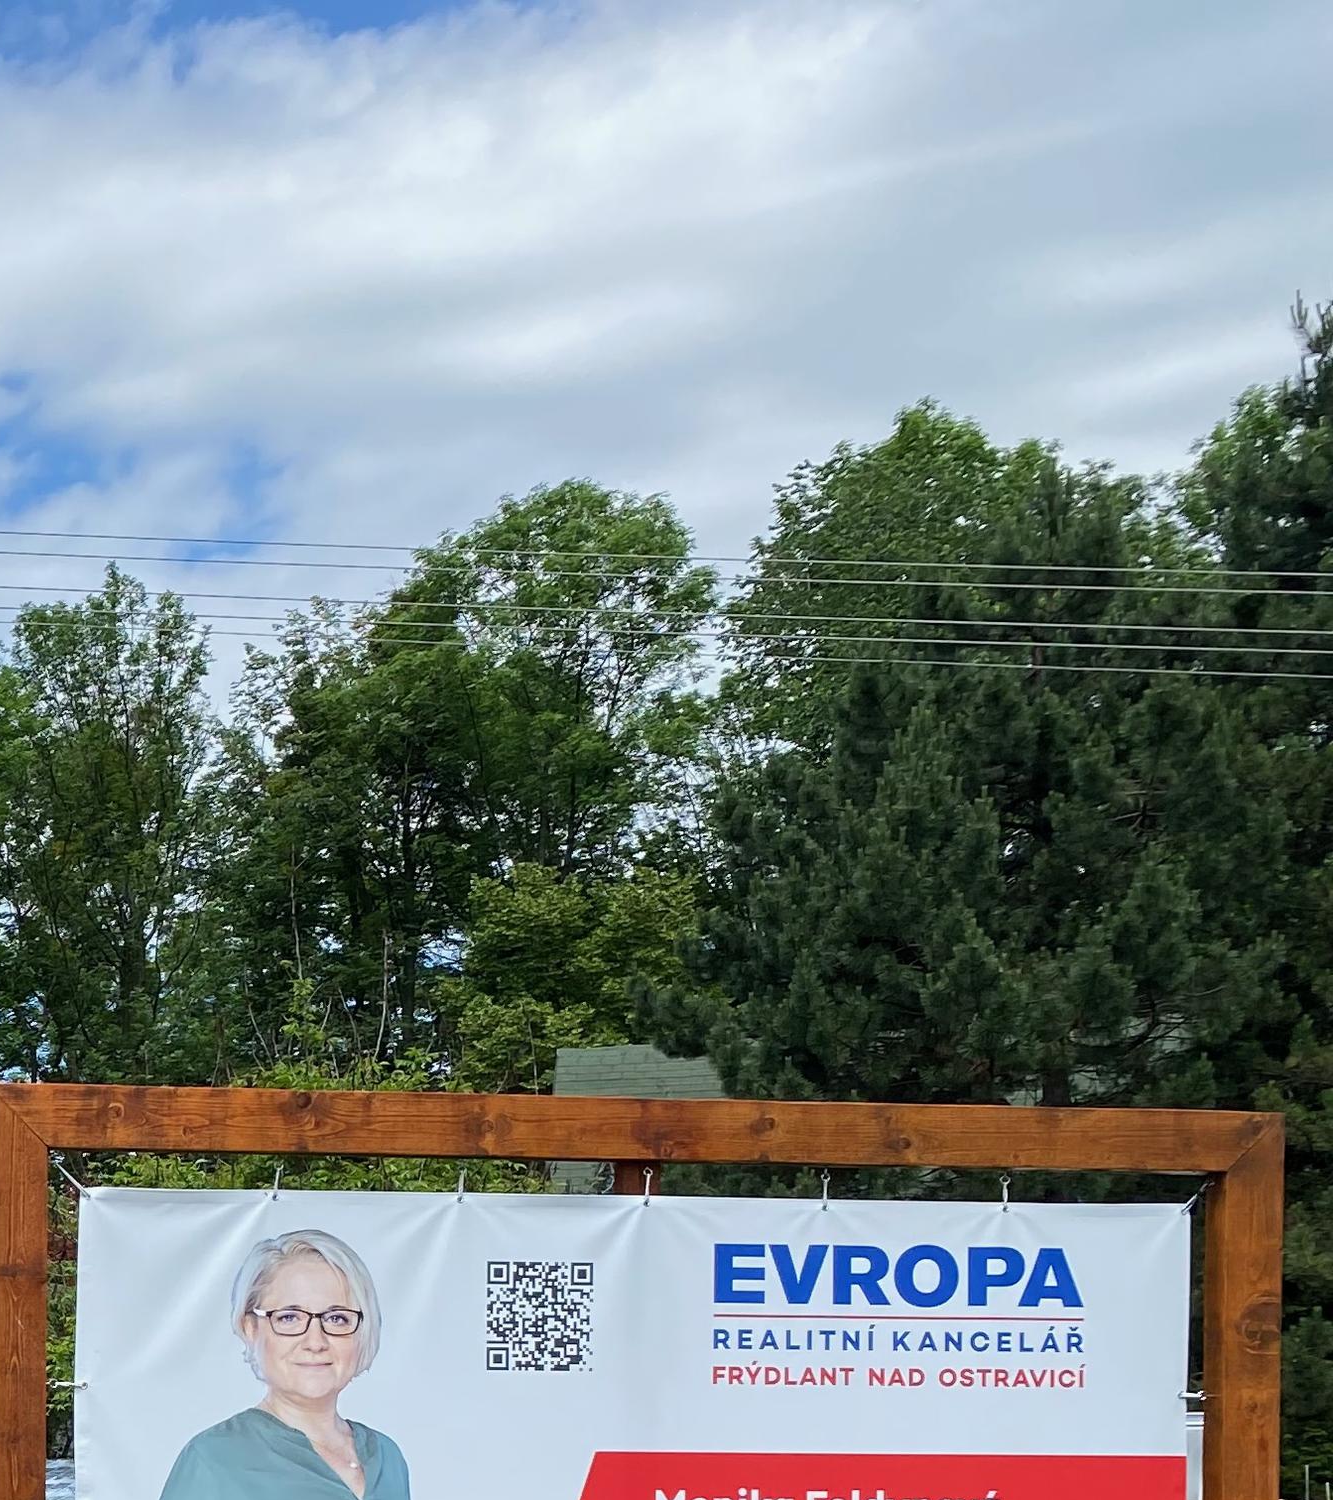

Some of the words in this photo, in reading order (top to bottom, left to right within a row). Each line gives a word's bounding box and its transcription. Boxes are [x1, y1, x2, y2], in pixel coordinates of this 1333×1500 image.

[712, 1241, 1085, 1308] EVROPA
[712, 1325, 876, 1351] REALITNÍ
[892, 1326, 1085, 1353] KANCELÁŘ
[711, 1361, 855, 1386] FRÝDLANT
[868, 1368, 926, 1386] NAD
[939, 1364, 1086, 1388] OSTRAVICÍ
